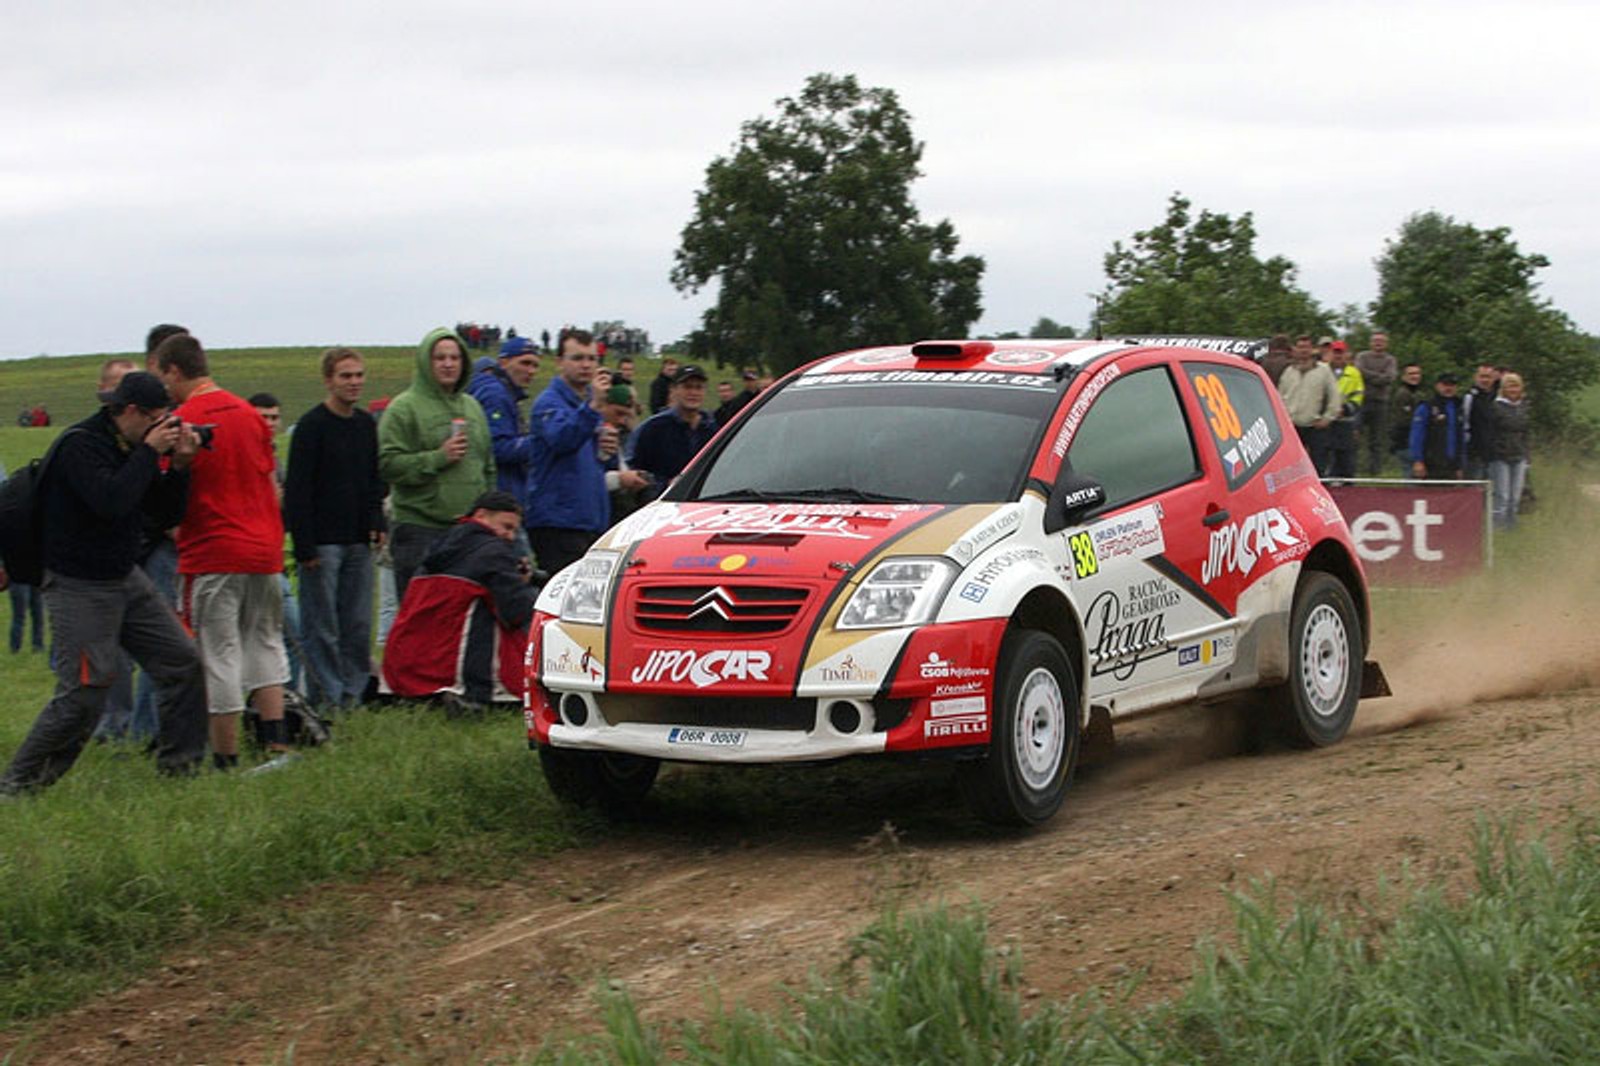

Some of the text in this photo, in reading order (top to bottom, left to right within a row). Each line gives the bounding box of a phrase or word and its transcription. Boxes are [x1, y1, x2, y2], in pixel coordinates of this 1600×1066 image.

[1194, 373, 1242, 442] 38
[1070, 533, 1096, 577] 38
[1201, 508, 1300, 585] JIPOCAR
[1122, 591, 1182, 619] GEARBOXES
[1128, 579, 1168, 601] RACING
[631, 649, 771, 688] JIPOCAR
[924, 715, 988, 737] PIRELLI
